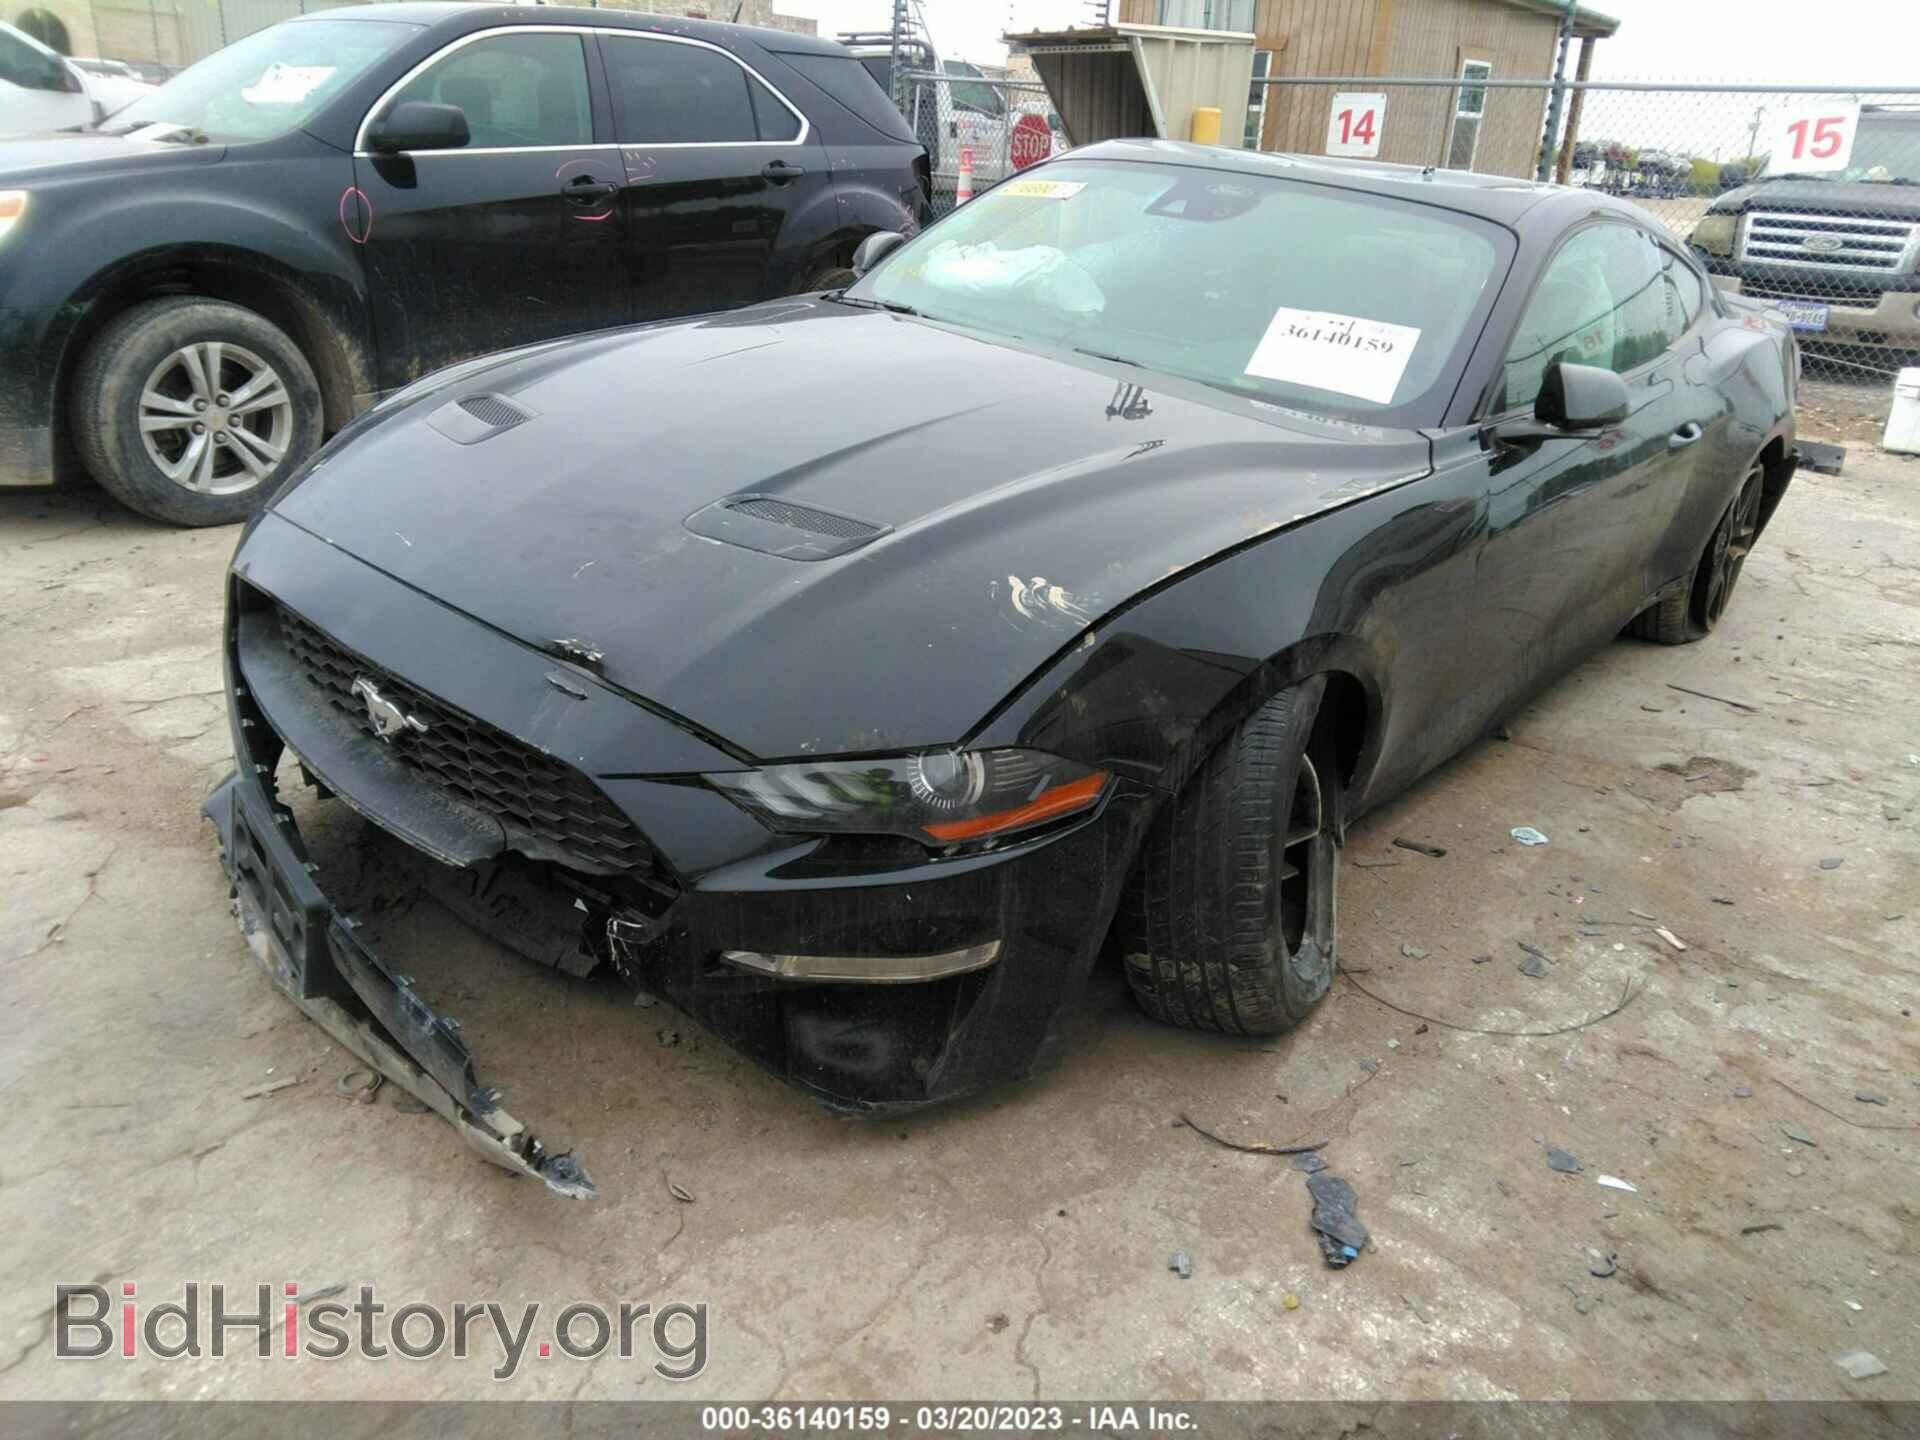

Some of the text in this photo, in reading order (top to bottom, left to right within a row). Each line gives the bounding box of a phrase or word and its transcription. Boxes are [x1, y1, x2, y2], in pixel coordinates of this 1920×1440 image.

[1338, 109, 1375, 145] 14
[1787, 116, 1846, 160] 15
[1013, 134, 1049, 158] STOP
[1281, 323, 1394, 354] 36140159
